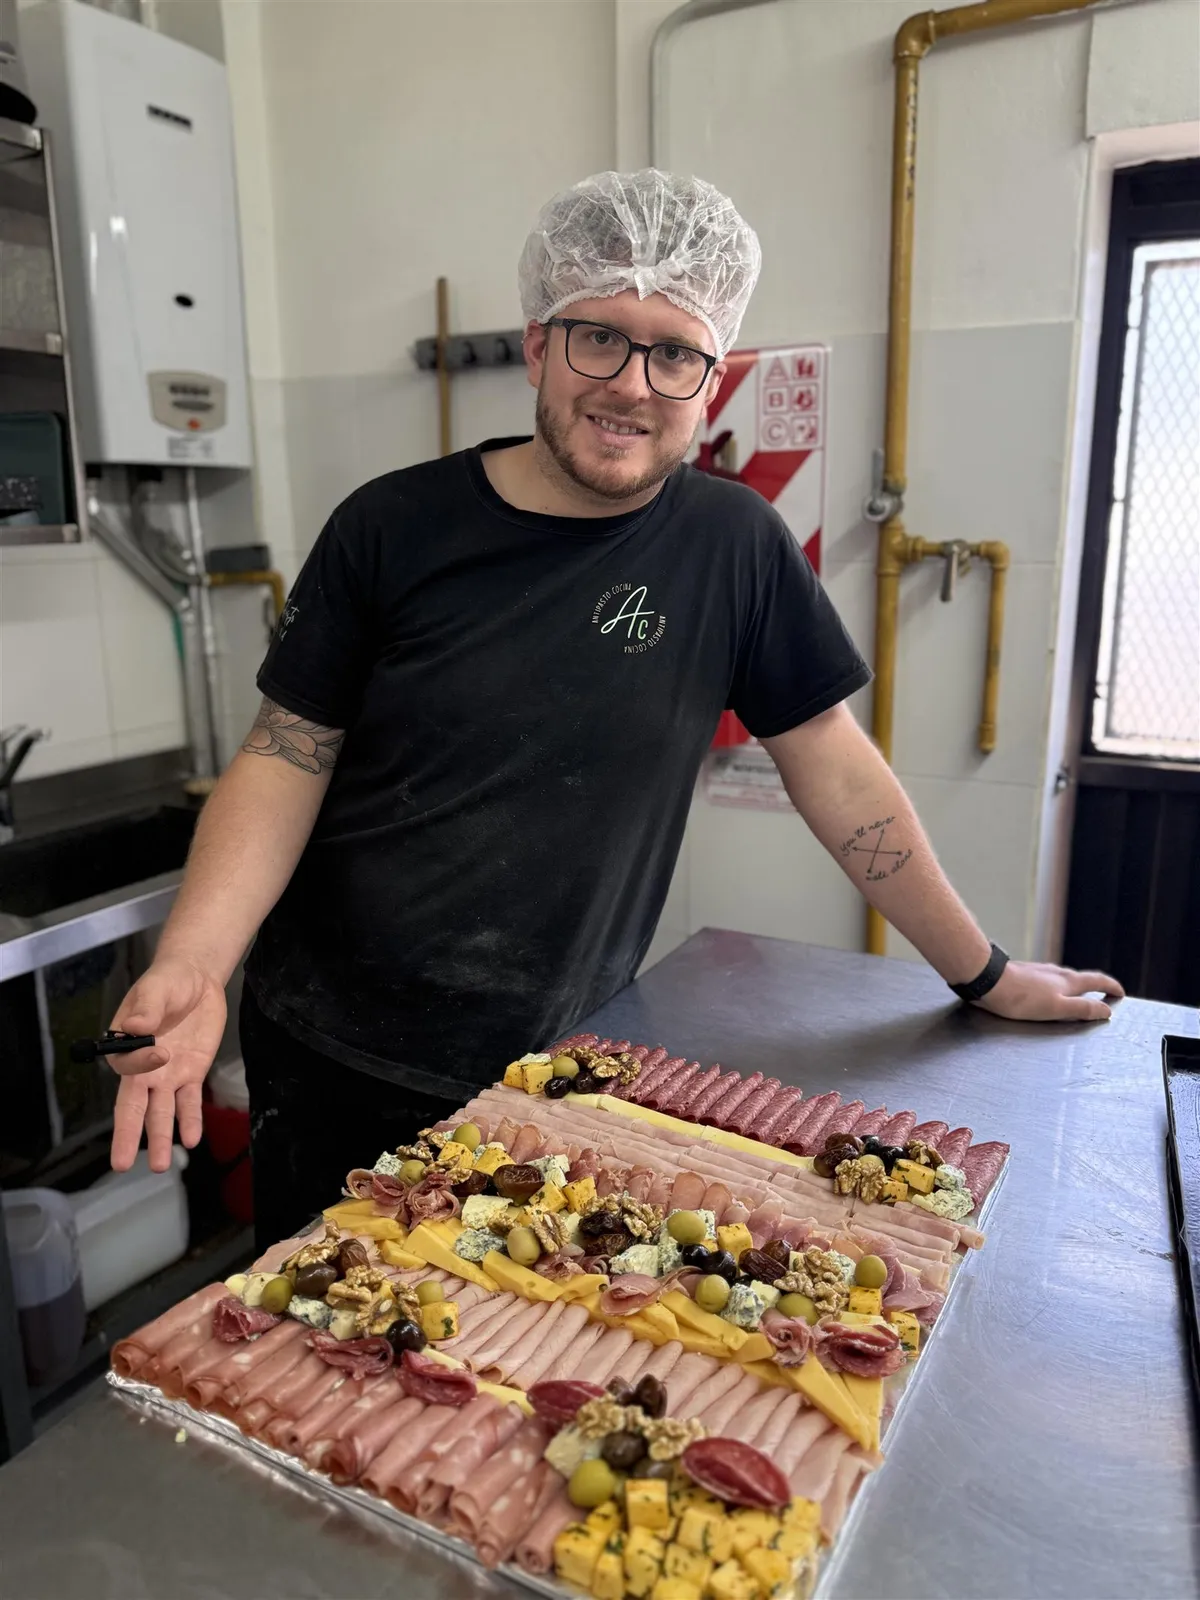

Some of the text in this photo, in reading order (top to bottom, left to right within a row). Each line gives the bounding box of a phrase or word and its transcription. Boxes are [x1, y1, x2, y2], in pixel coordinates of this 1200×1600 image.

[769, 391, 784, 407] B
[768, 423, 782, 441] C
[592, 583, 632, 624] ANTIPASTO COCINA
[624, 615, 666, 654] ANTIPASTO COCINA
[868, 816, 896, 831] never
